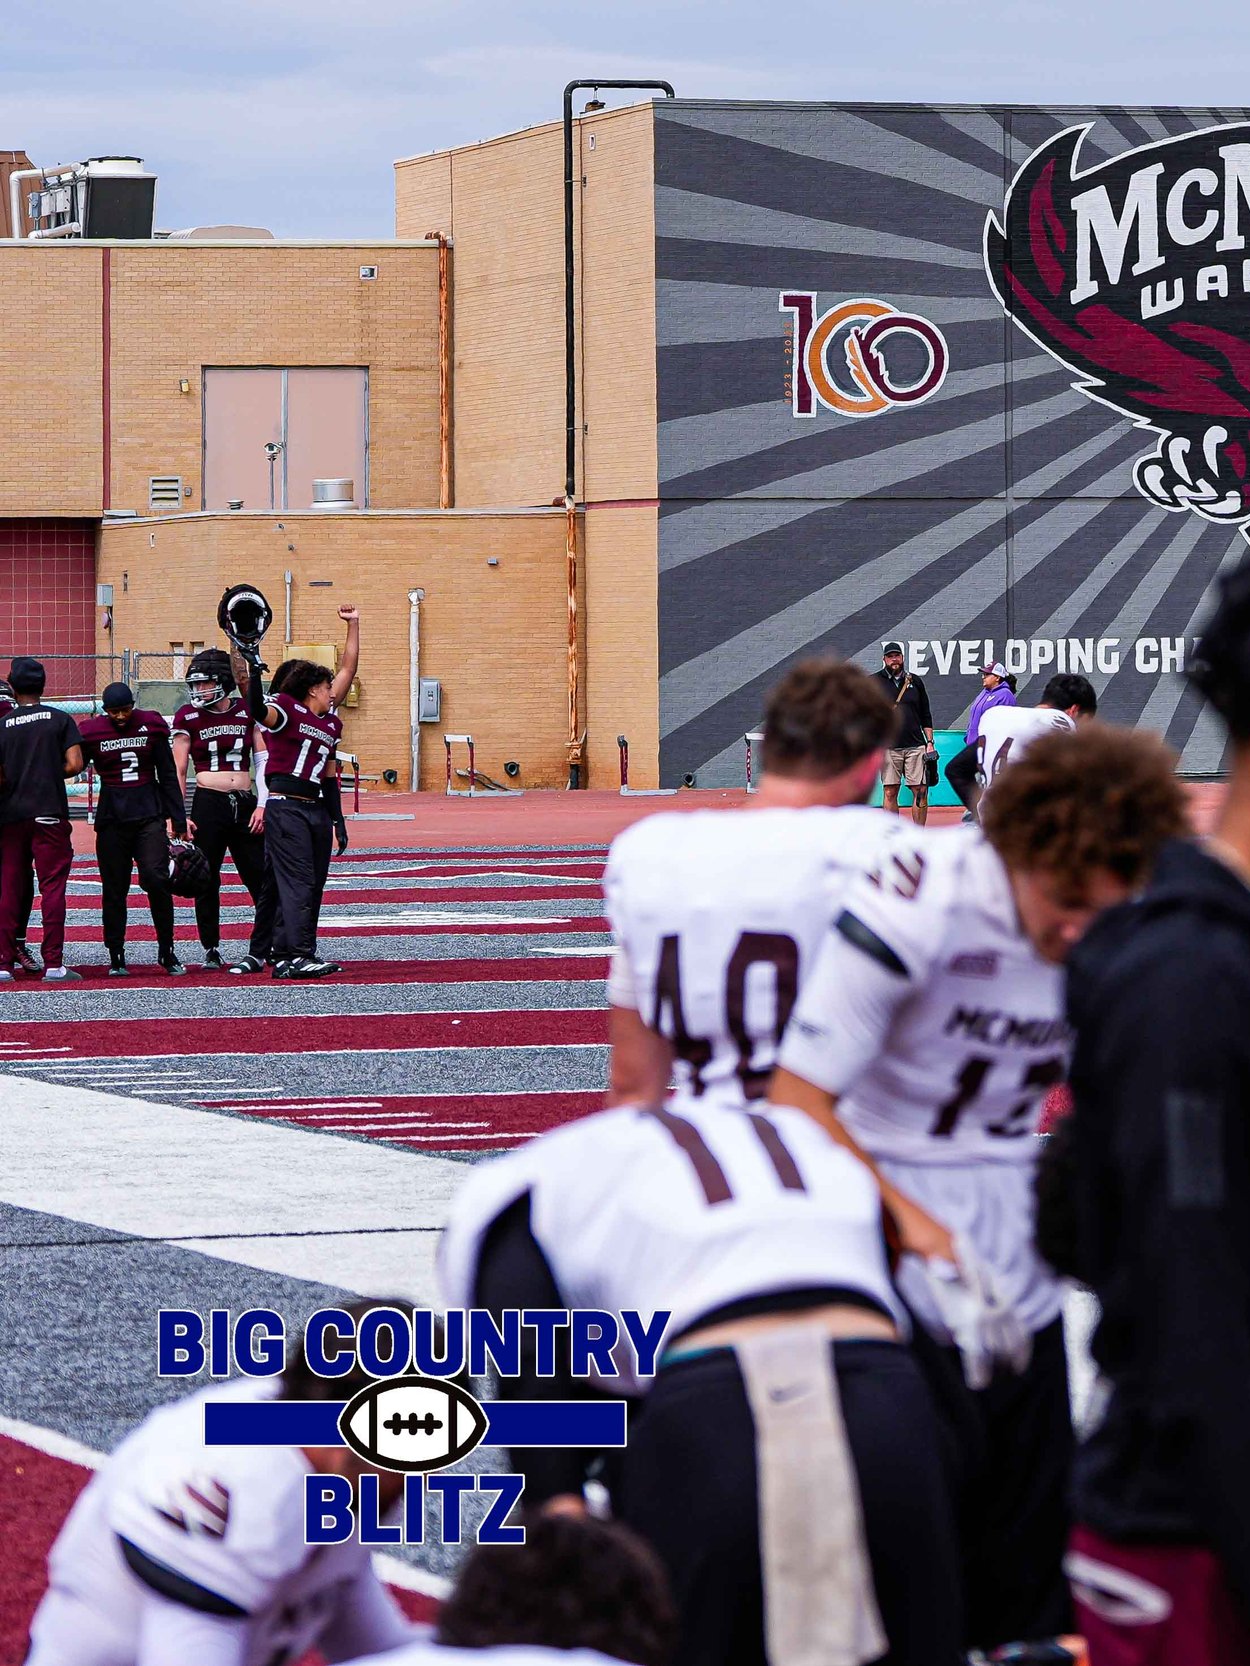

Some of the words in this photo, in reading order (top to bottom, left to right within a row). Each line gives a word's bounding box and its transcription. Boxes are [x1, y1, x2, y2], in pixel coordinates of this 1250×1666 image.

[100, 736, 149, 752] MCMURRY
[200, 724, 248, 741] MCMURRY
[120, 751, 140, 782] 2
[208, 738, 244, 772] 14
[651, 930, 800, 1100] 40
